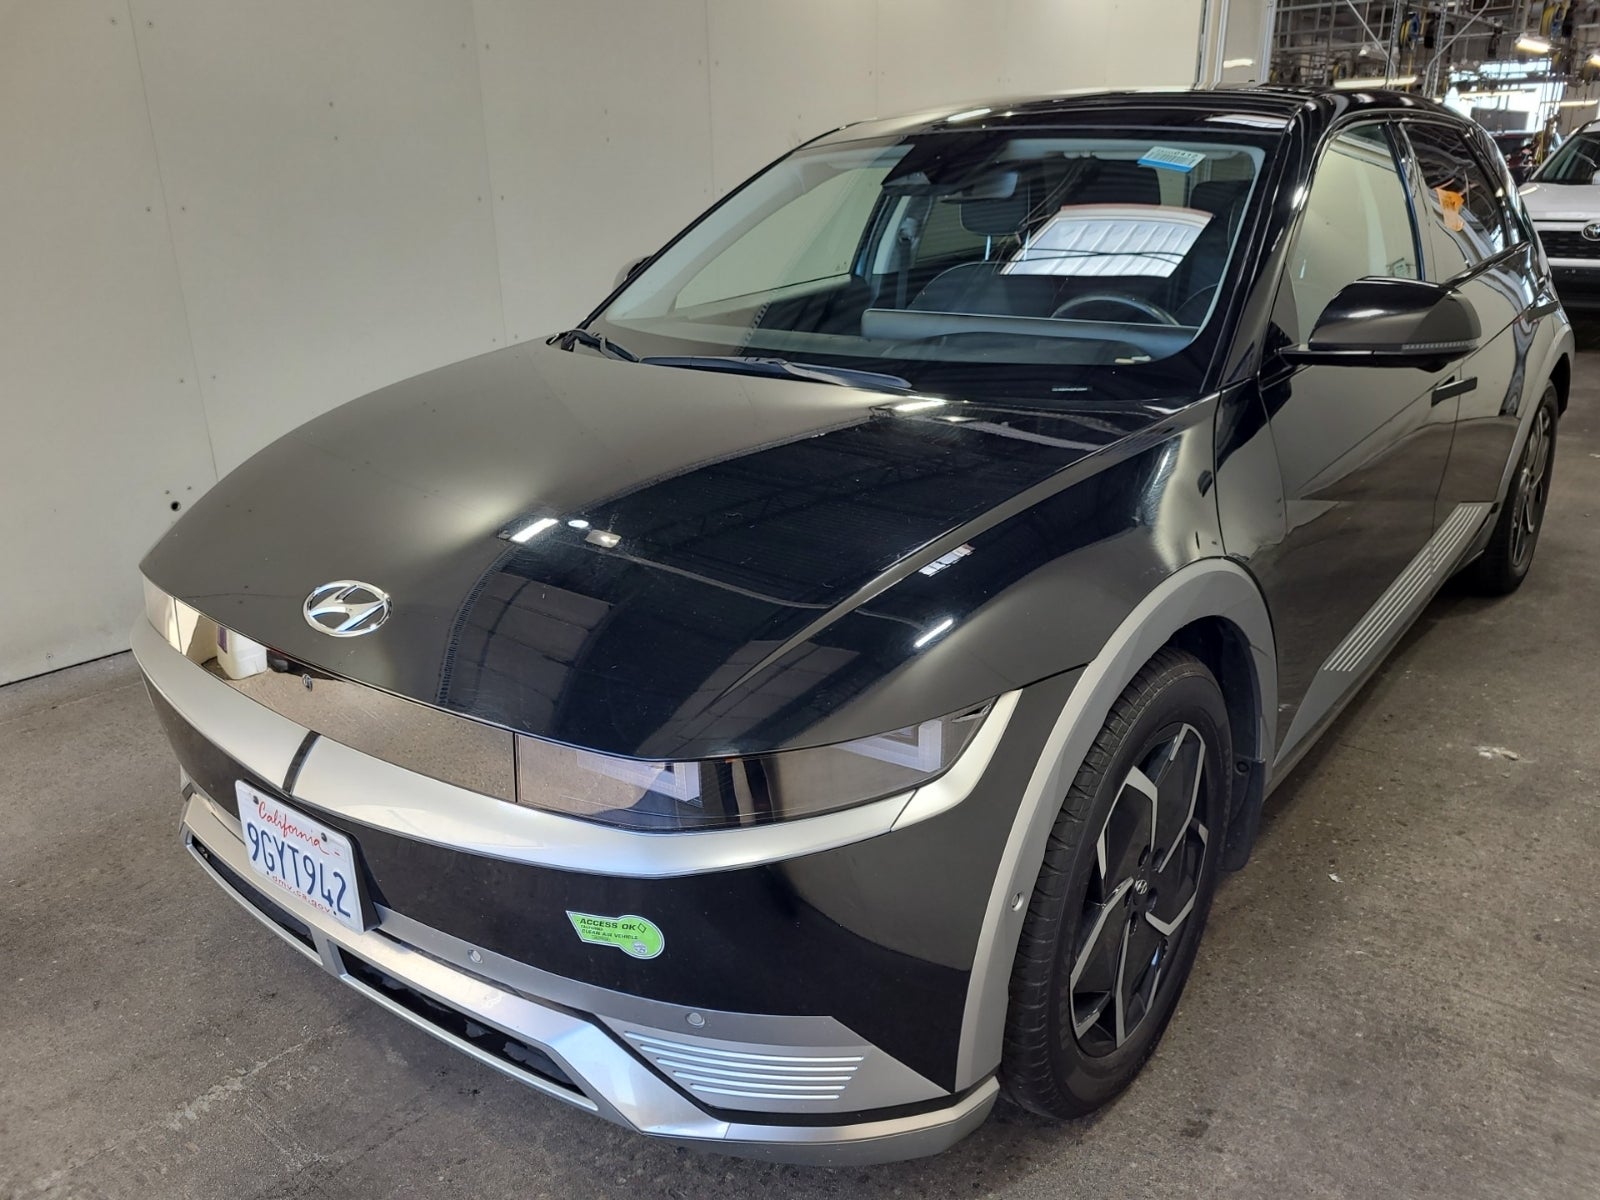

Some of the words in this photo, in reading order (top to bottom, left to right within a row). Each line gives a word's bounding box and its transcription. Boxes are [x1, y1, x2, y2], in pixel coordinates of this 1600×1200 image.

[258, 801, 321, 847] California
[247, 822, 351, 918] 9GYT942
[579, 918, 617, 928] ACCESS
